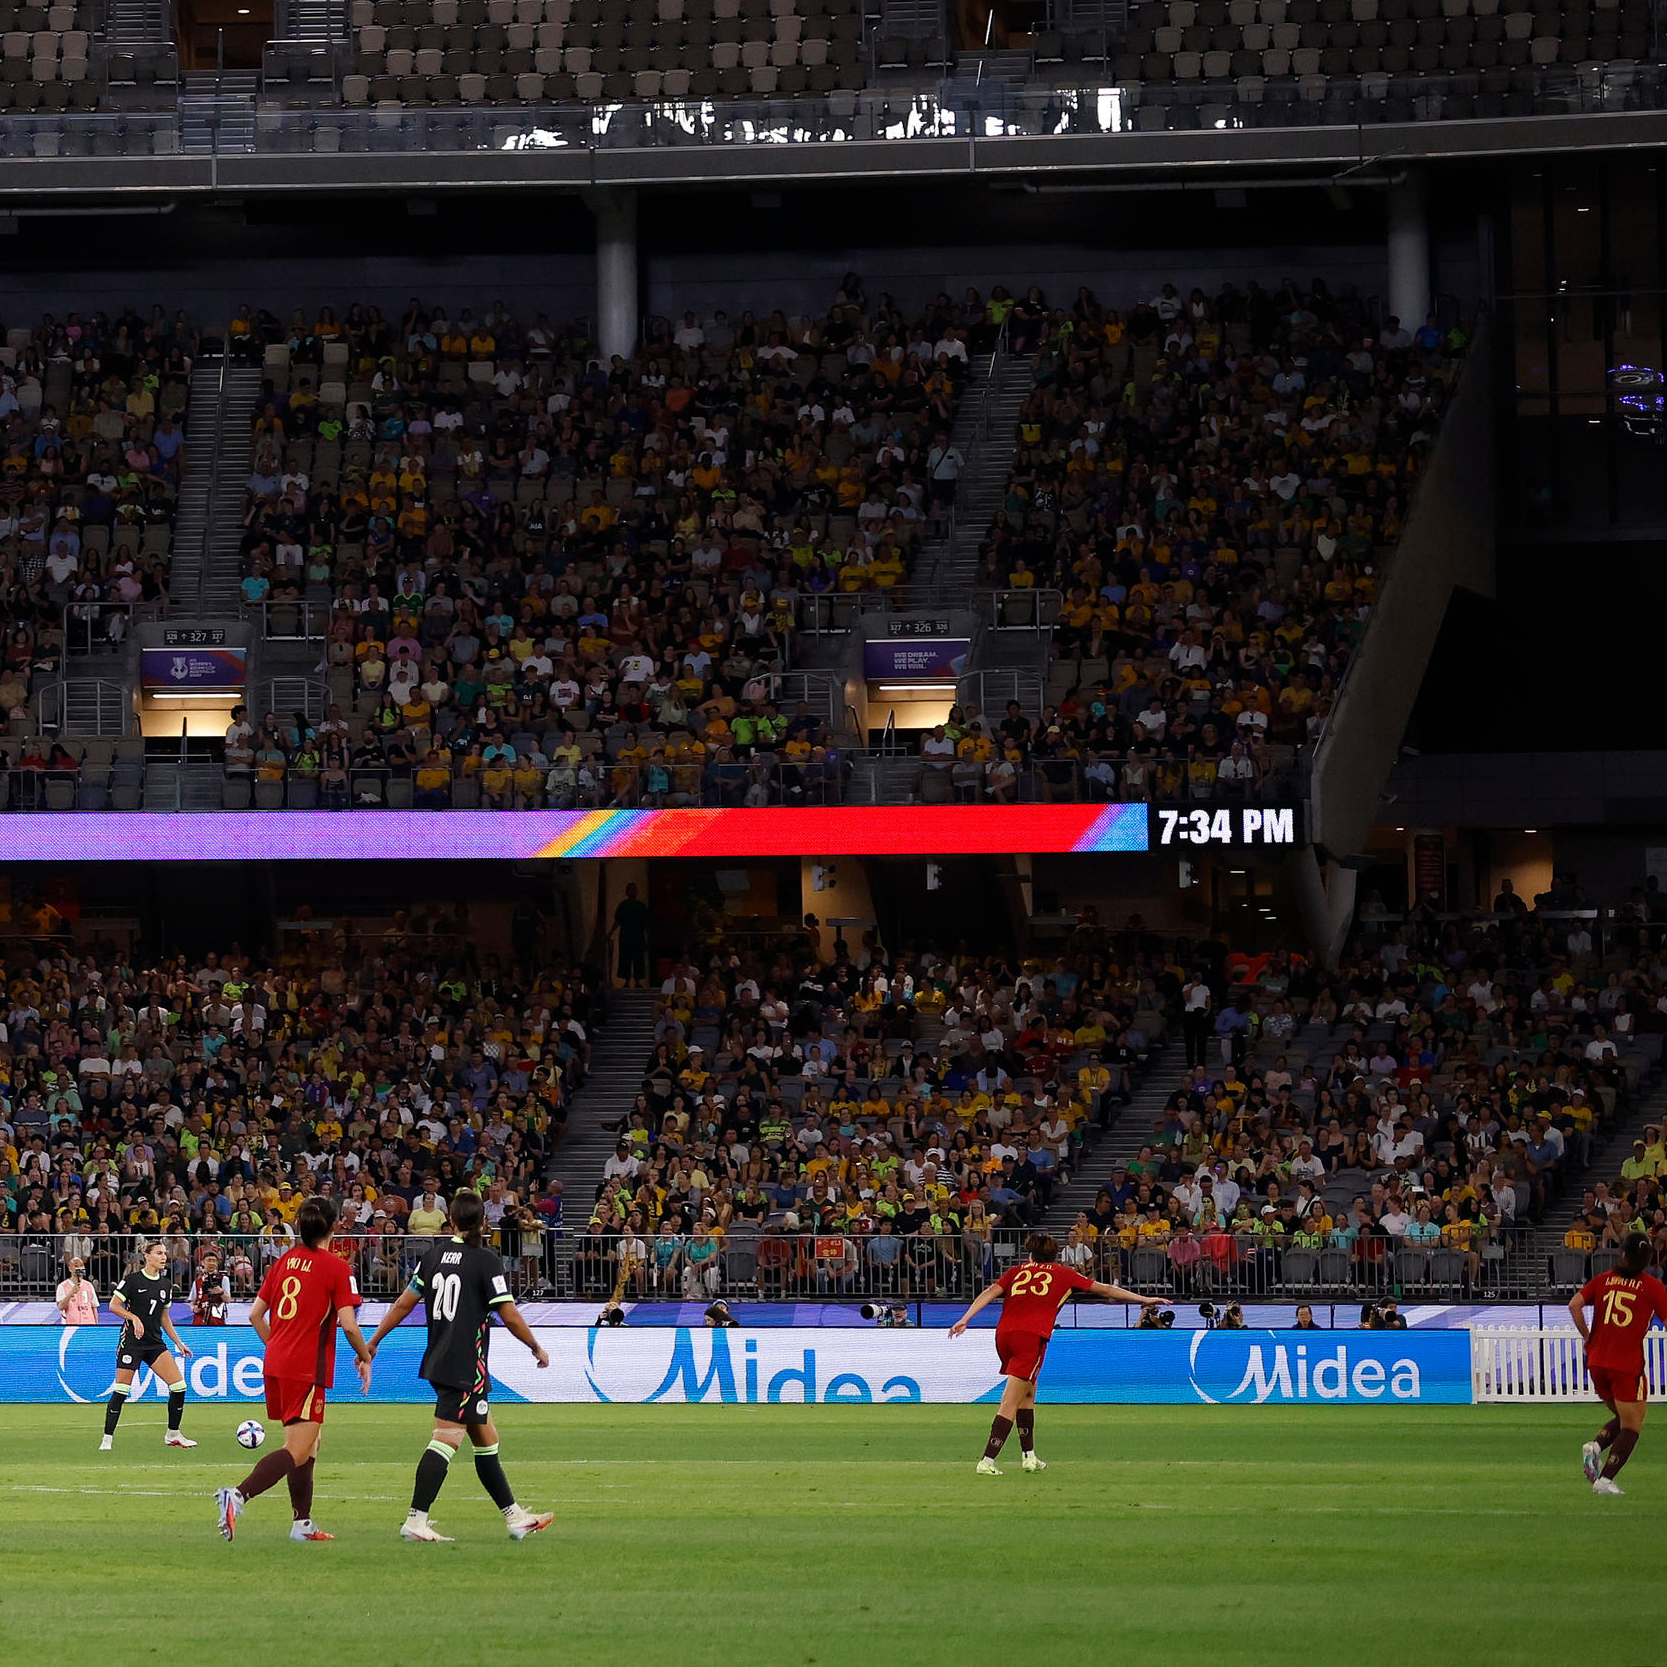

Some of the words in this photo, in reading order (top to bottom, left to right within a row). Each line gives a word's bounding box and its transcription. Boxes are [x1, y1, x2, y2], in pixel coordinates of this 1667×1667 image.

[190, 632, 207, 642] 327
[914, 623, 931, 632] 326
[1158, 808, 1232, 846] 7:34
[1243, 808, 1293, 844] PM
[441, 1252, 462, 1265] KERR
[277, 1276, 301, 1320] 8
[431, 1272, 461, 1322] 20
[1010, 1270, 1053, 1297] 23
[149, 1299, 157, 1315] 7
[1603, 1290, 1637, 1327] 15
[1228, 1345, 1421, 1402] Midea
